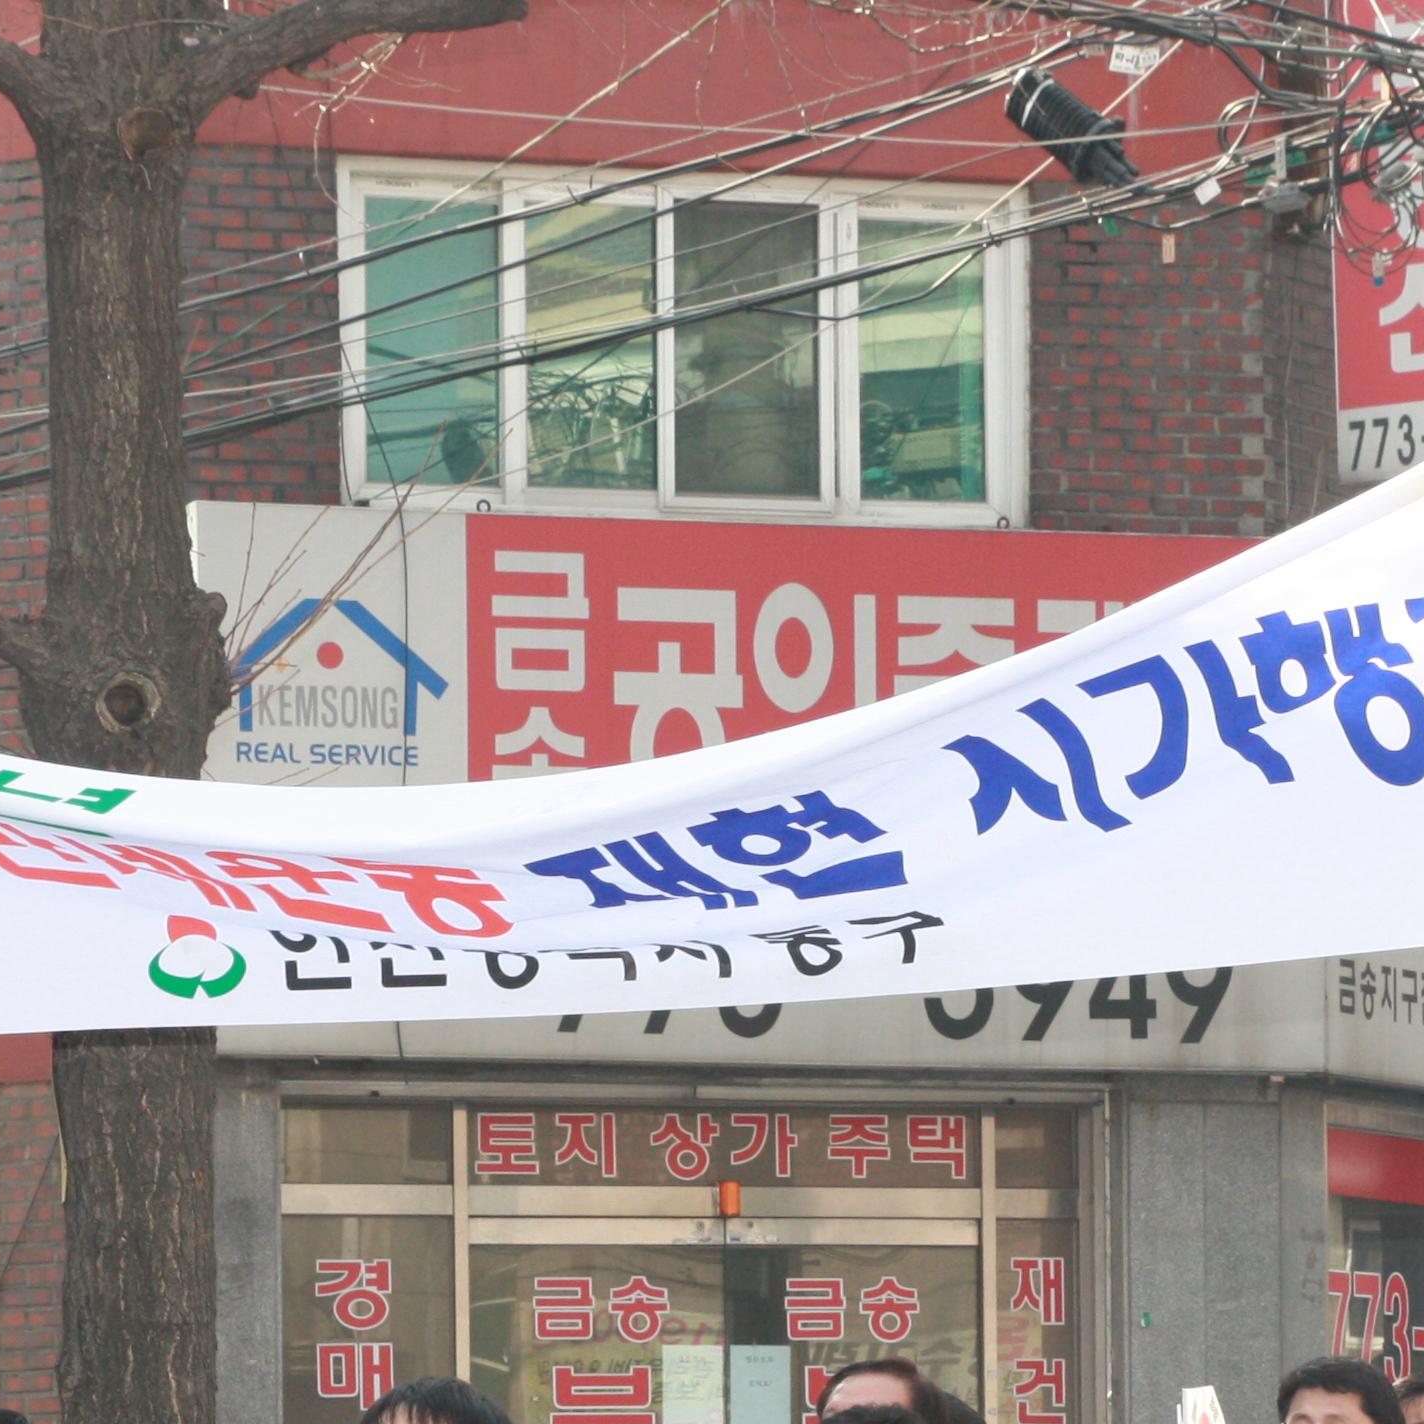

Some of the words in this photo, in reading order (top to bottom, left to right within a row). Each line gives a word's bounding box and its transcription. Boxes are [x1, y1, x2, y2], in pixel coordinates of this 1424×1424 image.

[258, 684, 399, 730] KEMSONG
[236, 741, 301, 765] REAL
[309, 742, 419, 768] SERVICE
[524, 789, 908, 909] 재현
[474, 1111, 617, 1179] 토지
[651, 1112, 799, 1182] 상가
[826, 1113, 967, 1180] 주택
[533, 1275, 671, 1344] 금송
[784, 1276, 920, 1343] 금송
